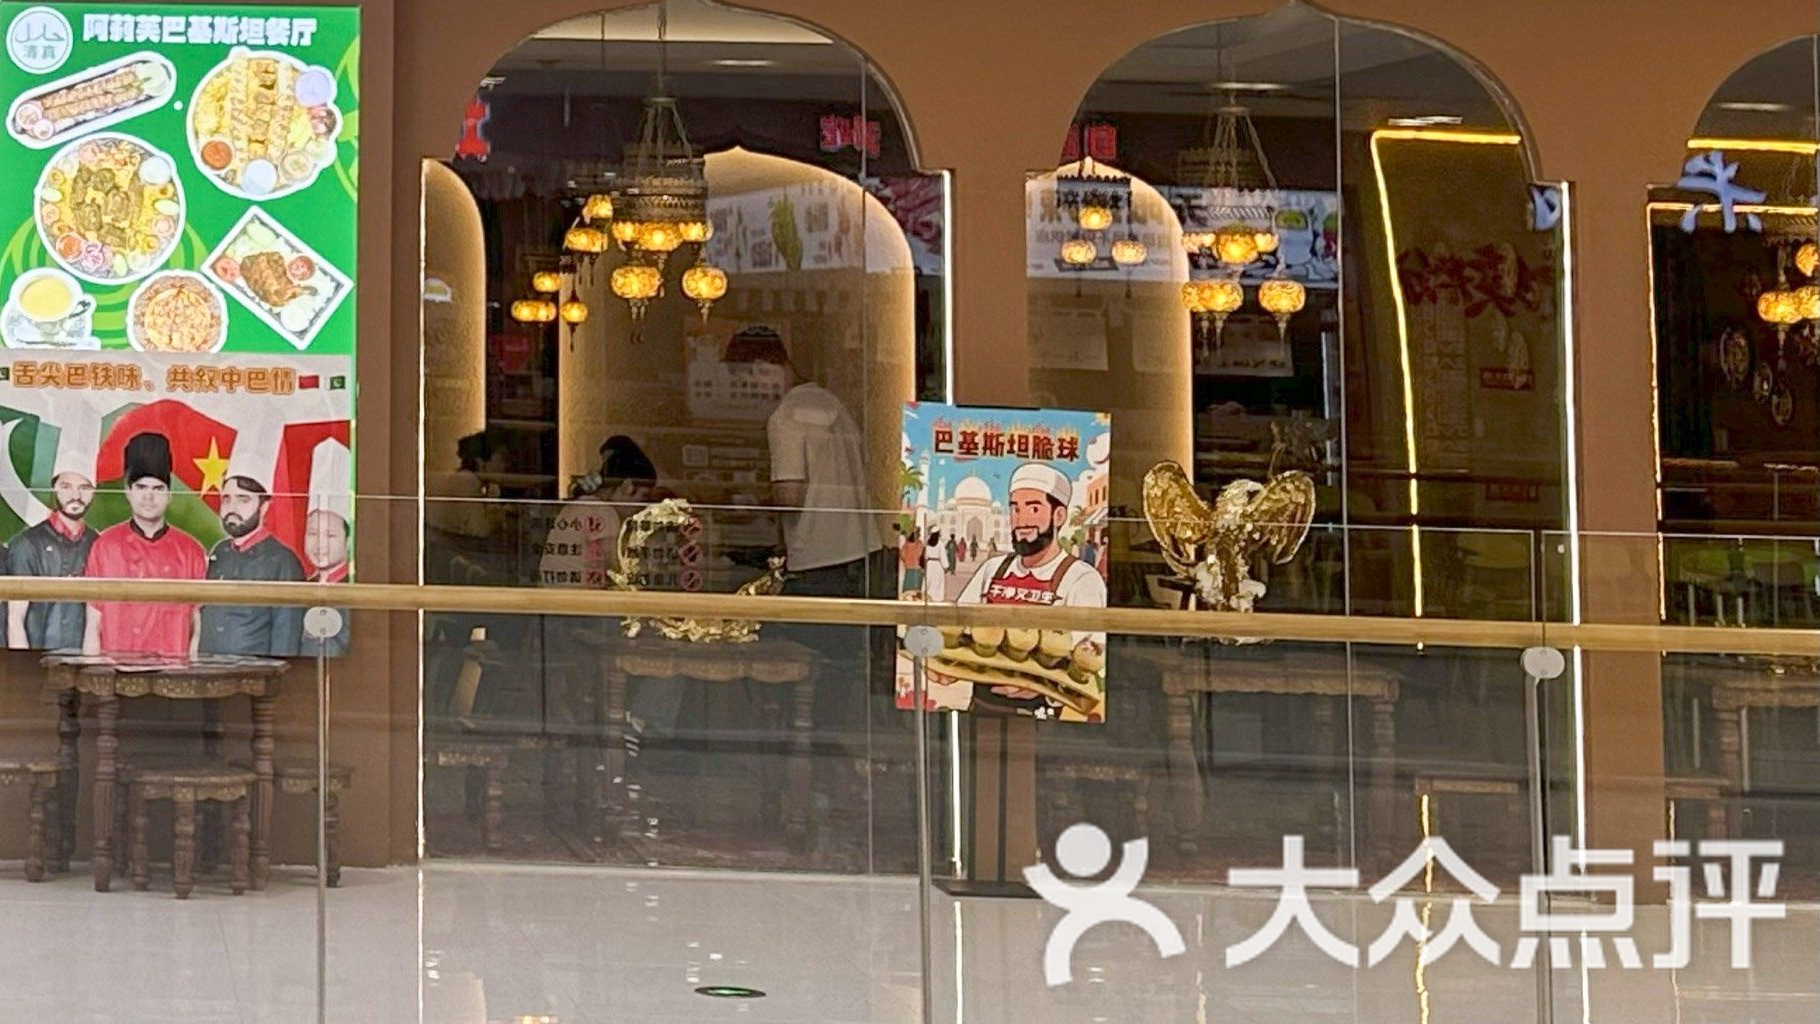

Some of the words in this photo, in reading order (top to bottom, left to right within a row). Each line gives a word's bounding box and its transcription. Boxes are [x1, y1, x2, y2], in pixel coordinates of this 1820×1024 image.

[82, 13, 318, 46] 阿莉芙巴基斯坦餐厅
[935, 430, 1079, 462] 巴基斯坦脆球
